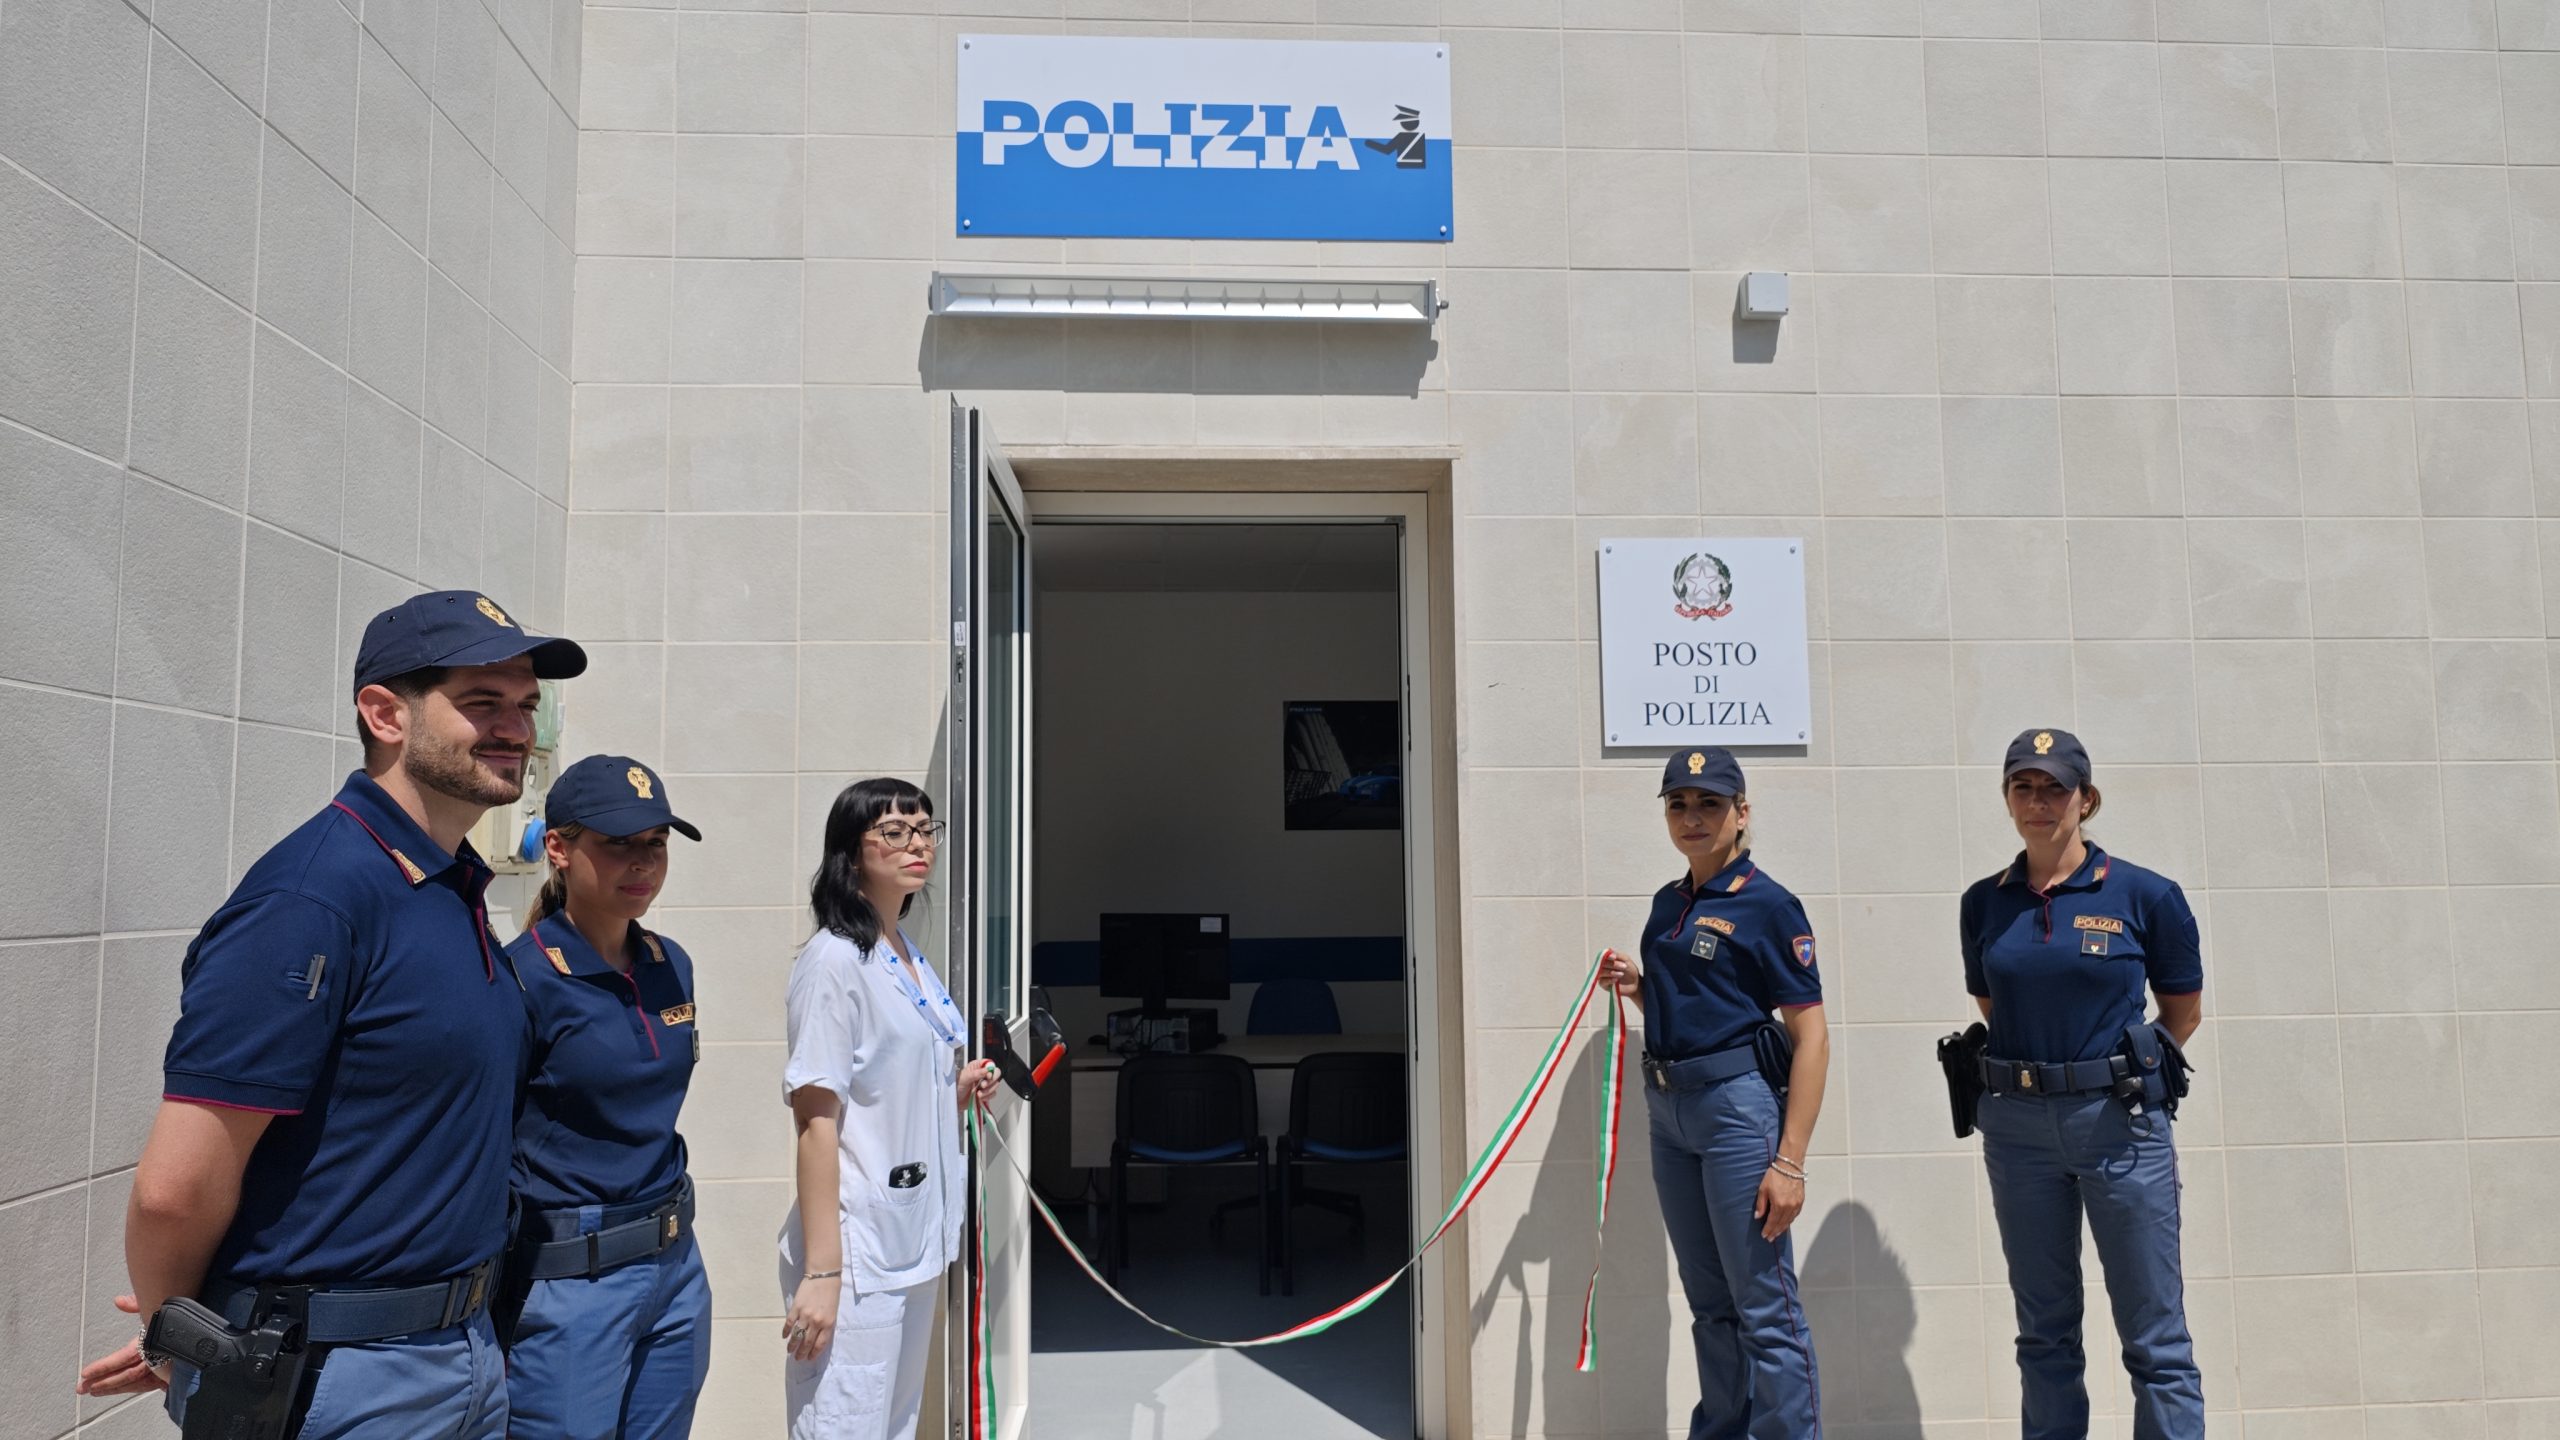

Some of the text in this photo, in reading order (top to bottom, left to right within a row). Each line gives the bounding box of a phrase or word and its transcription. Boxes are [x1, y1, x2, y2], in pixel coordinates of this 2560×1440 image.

[982, 99, 1360, 170] POLIZIA
[1652, 641, 1757, 667] POSTO
[1693, 675, 1719, 694] DI
[1643, 701, 1773, 726] POLIZIA
[2076, 917, 2120, 932] POLIZIA
[663, 1005, 694, 1024] POLIZI
